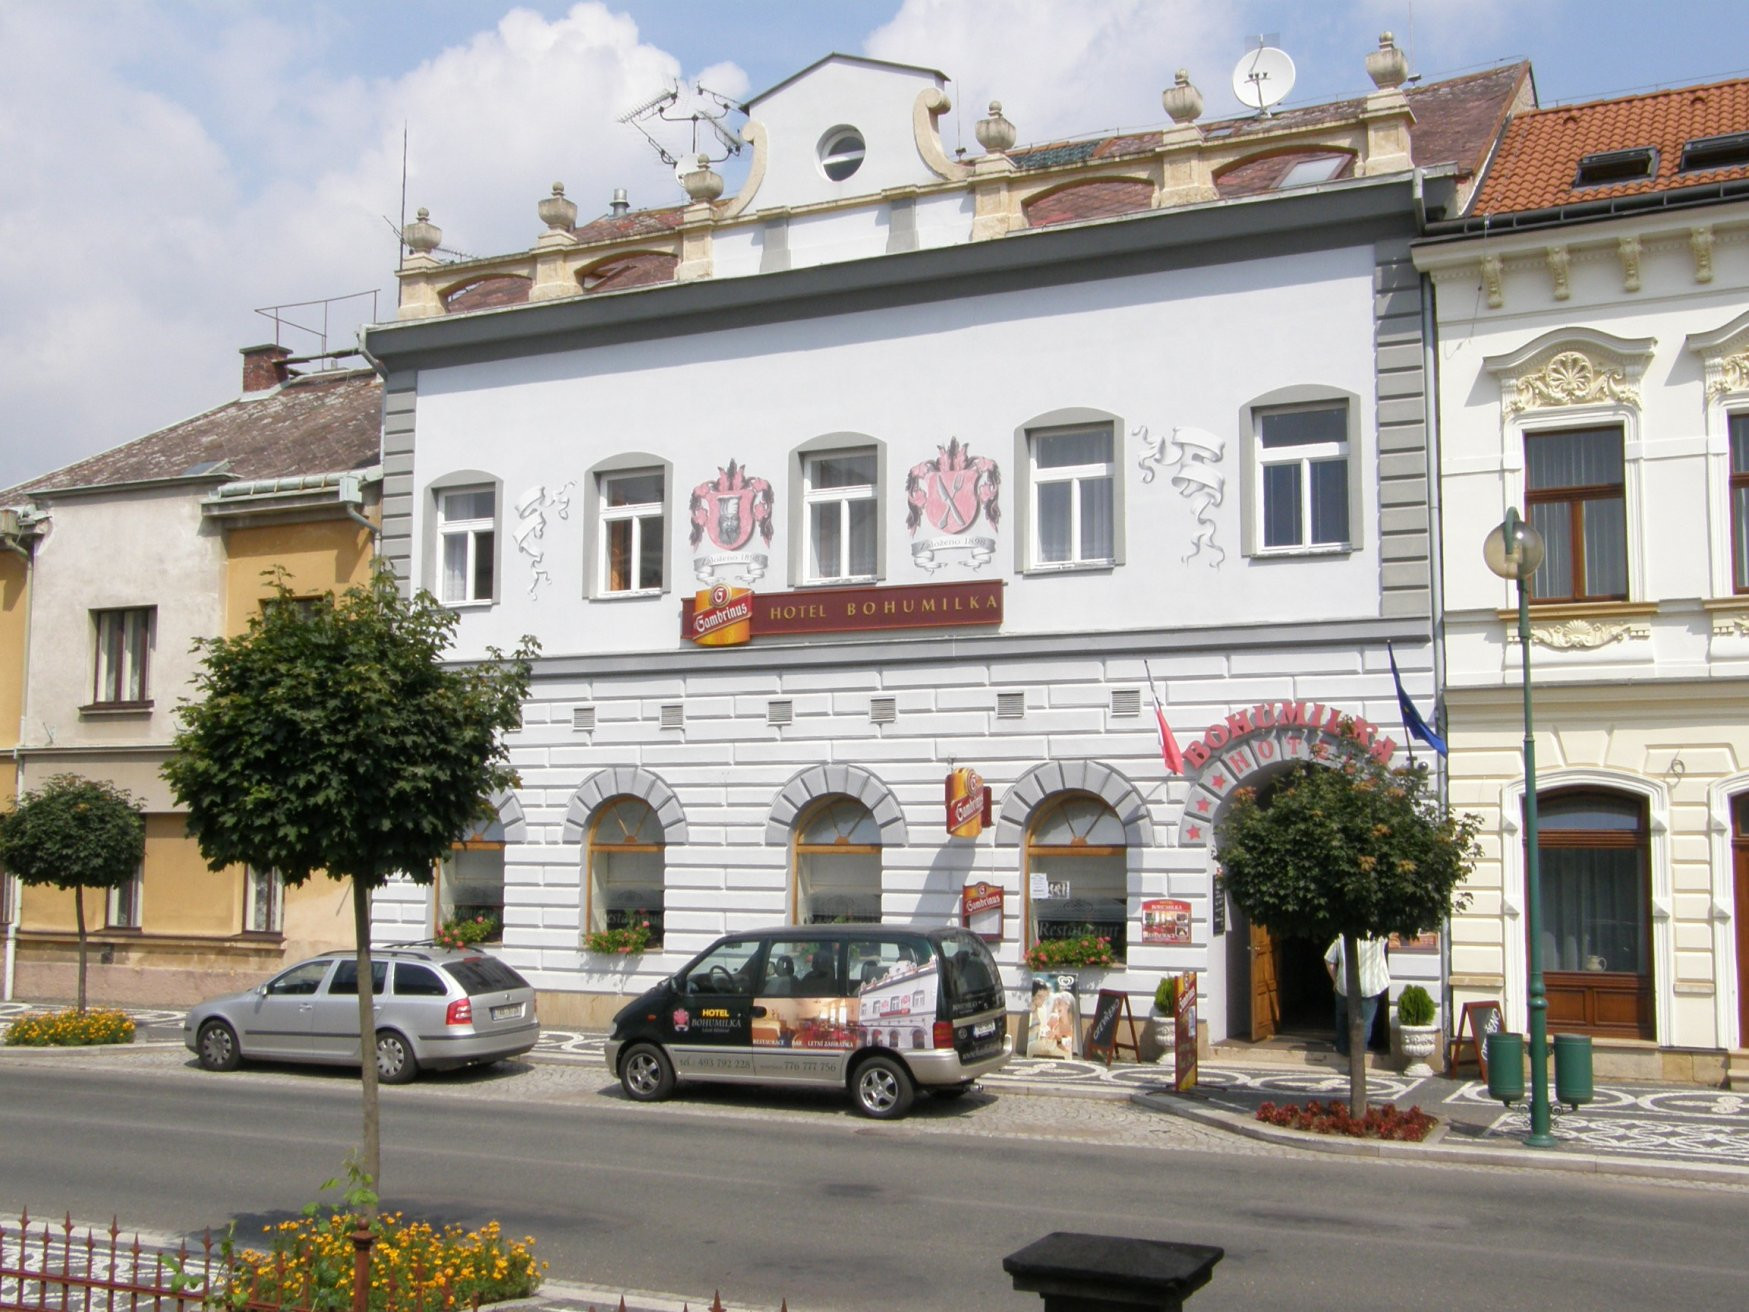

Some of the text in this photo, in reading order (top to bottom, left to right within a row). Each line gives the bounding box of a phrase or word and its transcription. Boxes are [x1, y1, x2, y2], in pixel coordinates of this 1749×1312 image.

[770, 594, 998, 620] HOTEL BOHUMILKA
[695, 602, 748, 632] Gambrinus
[966, 894, 1001, 912] Gambrinus
[702, 1009, 730, 1017] HOTEL
[691, 1018, 742, 1028] BOHUMILKA
[802, 1061, 818, 1071] 777
